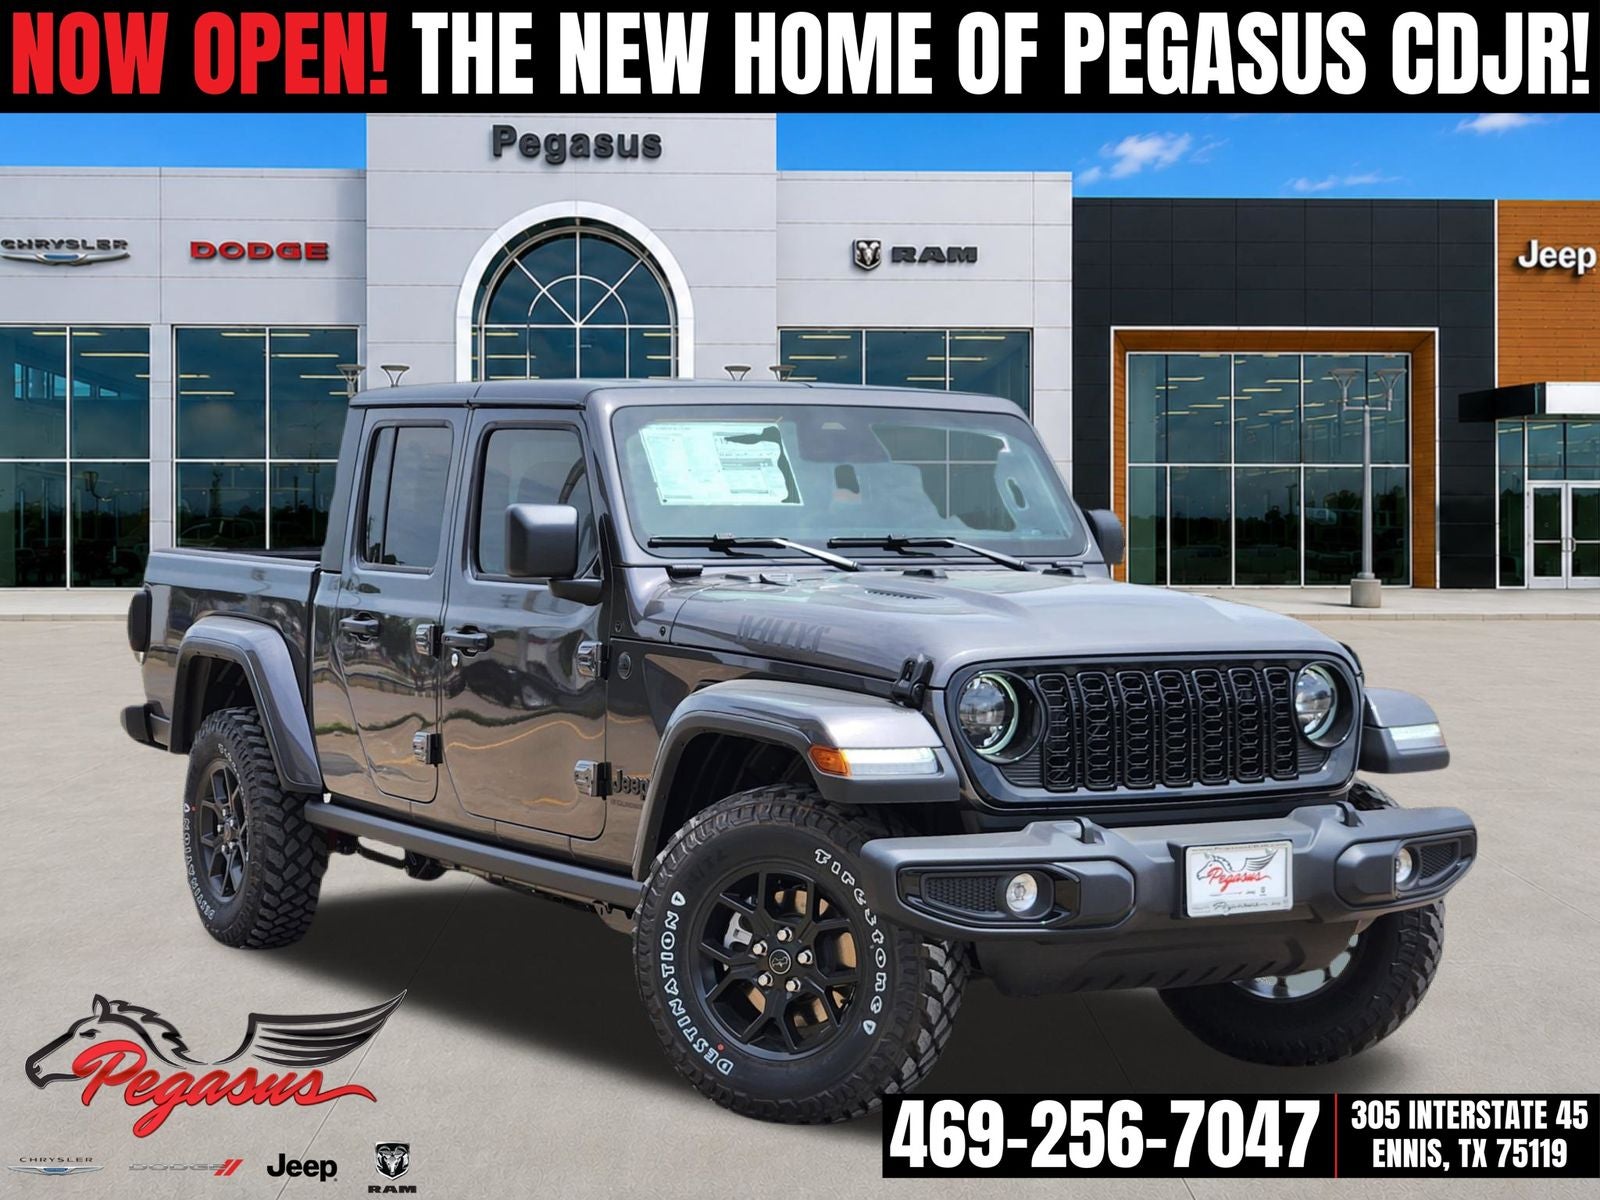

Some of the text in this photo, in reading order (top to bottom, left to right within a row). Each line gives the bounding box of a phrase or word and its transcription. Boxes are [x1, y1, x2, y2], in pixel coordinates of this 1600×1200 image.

[492, 124, 662, 165] Pegasus
[0, 238, 128, 250] CHRYSLER
[189, 240, 329, 261] DODGE
[891, 246, 978, 263] RAM
[1517, 239, 1597, 275] Jeep
[1206, 866, 1271, 893] Pegasus
[660, 910, 735, 1076] DESTINATION
